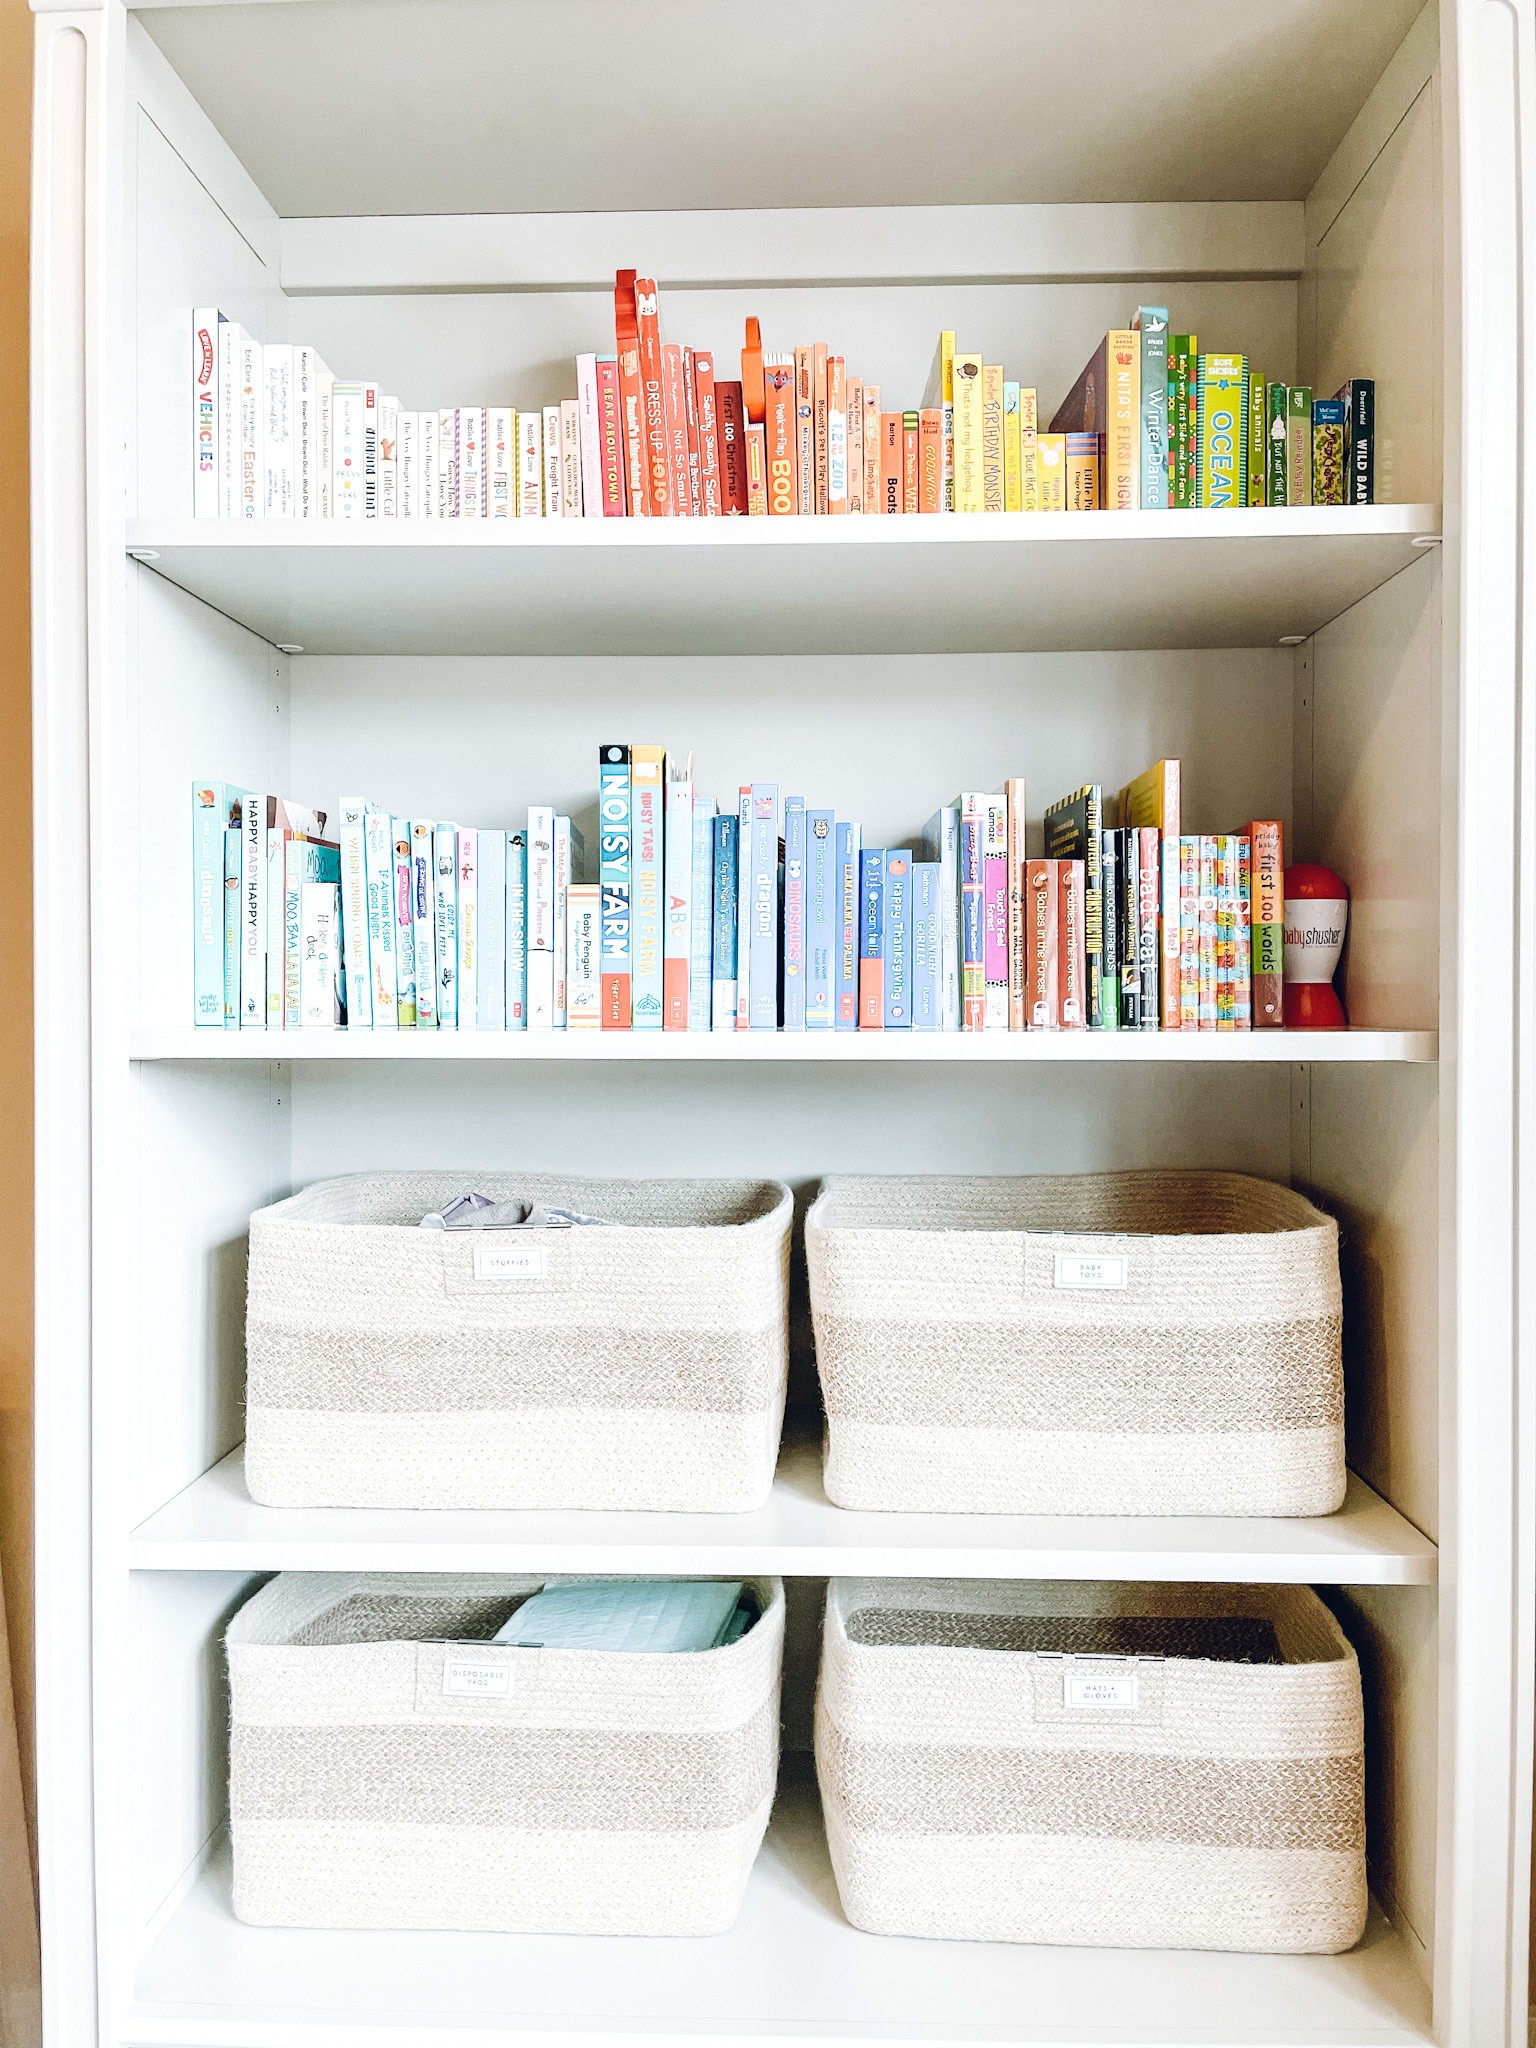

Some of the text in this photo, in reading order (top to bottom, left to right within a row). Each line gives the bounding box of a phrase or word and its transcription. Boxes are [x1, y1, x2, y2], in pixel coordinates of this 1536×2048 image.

[244, 349, 252, 383] Eric Carle
[199, 391, 213, 471] VEHICLES
[700, 394, 714, 431] Squishy
[775, 403, 787, 456] Peek-a-Flap
[1176, 354, 1188, 500] Baby's very first Slide and see Farm
[1253, 387, 1263, 452] Baby animals
[549, 415, 559, 512] Crews Freight Train
[604, 387, 619, 503] BEAR ABOUT TOWN
[629, 438, 642, 489] Marching
[646, 381, 667, 502] DRESS UP JOJO
[673, 429, 688, 507] Not So Small
[724, 394, 738, 497] first 100 Christmas
[1148, 389, 1164, 504] Winter Dance
[1209, 410, 1234, 508] OCEAN
[1274, 441, 1284, 492] BUT NOT THE
[243, 451, 256, 502] Easter
[464, 471, 477, 505] THINGS
[494, 471, 508, 500] FIRST
[772, 459, 792, 513] BOO
[801, 426, 810, 513] Mickey's Thanksgiving
[887, 478, 898, 514] Boats
[925, 445, 937, 509] GOODNIGHT
[1084, 469, 1093, 495] Little
[1357, 439, 1368, 506] WILD BABY
[302, 495, 308, 503] Do
[633, 490, 644, 517] Band
[641, 792, 653, 824] NOISY
[741, 798, 750, 826] Church
[988, 807, 997, 843] Lamaze
[463, 841, 471, 856] REY
[534, 858, 548, 887] Penguin
[602, 774, 629, 958] NOISY FARM
[815, 842, 827, 868] That's
[1088, 837, 1100, 876] LOVELOCK
[248, 800, 258, 956] HAPPY BABY HAPPY YOU
[512, 883, 524, 898] IN
[813, 890, 825, 905] my
[816, 871, 826, 887] not
[996, 888, 1006, 916] Touch
[199, 869, 216, 945] dinosaur!
[370, 883, 381, 939] Good Night
[378, 869, 392, 952] If Animals Kissed
[512, 901, 524, 926] THE
[537, 901, 549, 934] Pinecone
[639, 870, 656, 976] NOISY FARM
[756, 873, 773, 937] dragon!
[789, 880, 803, 961] DINOSAURS
[844, 864, 854, 980] LLAMA LLAMA RED PAJAMA
[867, 891, 880, 956] Ocean tails
[986, 903, 996, 932] Forest
[1086, 889, 1102, 954] CONSTRUCTION
[1105, 873, 1116, 970] Hello, OCEAN FRIENDS
[1126, 884, 1136, 961] Peekaboo Morning
[1140, 868, 1159, 973] bad cat
[1261, 854, 1276, 971] first 100 words
[306, 935, 317, 960] dock
[447, 929, 455, 939] ME
[512, 930, 525, 972] SNOW
[581, 913, 592, 979] Baby Penguin
[890, 882, 905, 1001] Happy Thanksgiving
[916, 920, 926, 966] GORILLA
[996, 928, 1005, 947] Feel
[1037, 890, 1047, 994] Babies in the Forest
[1067, 889, 1077, 992] Babies in the Forest
[287, 973, 300, 987] LA
[288, 954, 300, 970] LA
[611, 979, 620, 1021] tiger tales
